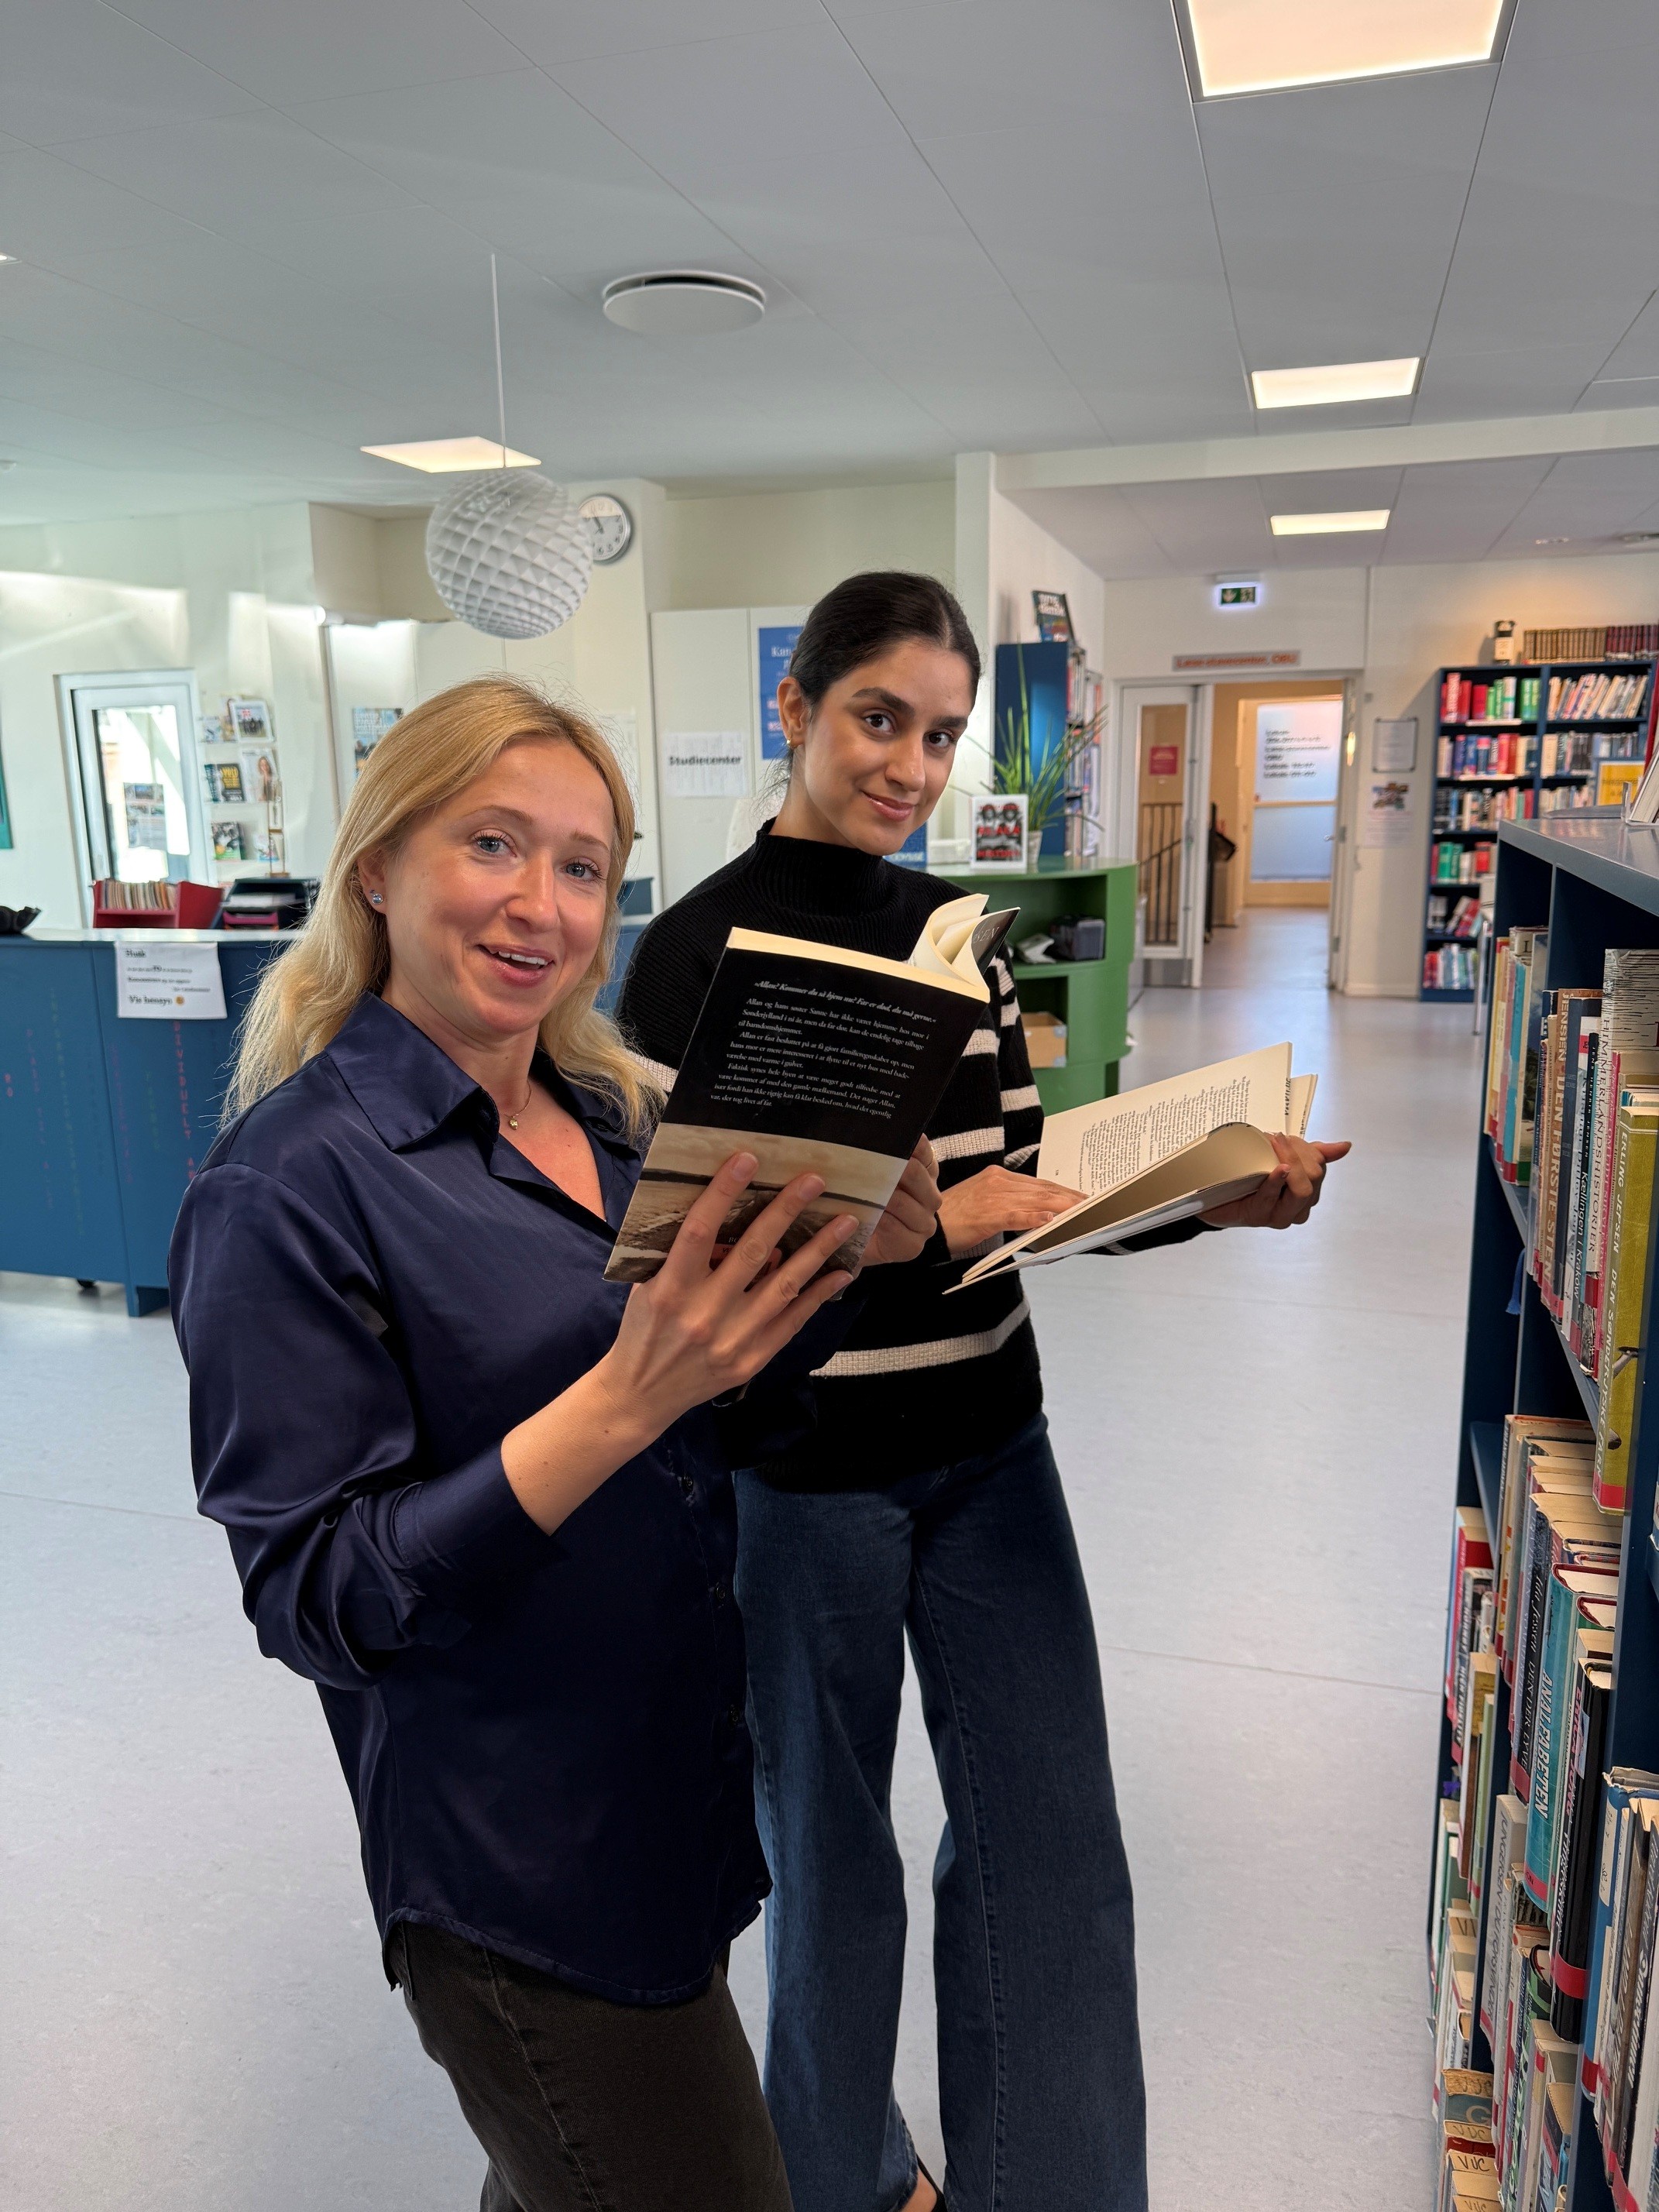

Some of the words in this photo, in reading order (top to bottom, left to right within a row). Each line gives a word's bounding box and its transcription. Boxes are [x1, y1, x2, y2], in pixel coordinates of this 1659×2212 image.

[668, 753, 744, 767] Studiecenter
[974, 926, 1000, 944] SEN
[742, 1009, 784, 1020] Sønderjylland
[869, 1032, 891, 1042] endelig
[905, 1040, 924, 1050] tilbage
[746, 998, 763, 1006] Allan
[809, 1008, 828, 1016] Sanne
[840, 1013, 854, 1022] ikke
[873, 1020, 898, 1032] hjemme
[898, 1026, 910, 1035] hos
[1557, 992, 1570, 1062] JENSEN
[727, 1063, 748, 1071] Faktisk
[775, 1036, 801, 1046] besluttet
[840, 1047, 889, 1063] familieregnskabet
[782, 1049, 814, 1059] interesseret
[826, 1055, 841, 1063] flytte
[733, 1073, 758, 1083] kommet
[1554, 1075, 1565, 1121] DEN
[812, 1096, 833, 1104] besked
[844, 1101, 860, 1110] hvad
[869, 1109, 891, 1118] egentlig
[1588, 1019, 1610, 1252] HIMMERLANDSHISTORIER
[1547, 1129, 1564, 1212] FØRSTE
[1617, 1132, 1628, 1187] ERLING
[1577, 1171, 1589, 1235] Kællingen
[1613, 1194, 1623, 1254] JEPSEN
[1544, 1219, 1556, 1281] STEN
[1573, 1249, 1582, 1299] Krakow
[1609, 1269, 1617, 1304] DEN
[1599, 1309, 1614, 1429] SØNDERJYSKE
[1595, 1431, 1605, 1478] FARM
[1534, 1575, 1543, 1602] Ida
[1530, 1600, 1541, 1654] Jessen
[1527, 1661, 1535, 1695] DEN
[1524, 1696, 1534, 1728] DER
[1569, 1685, 1582, 1754] ERICA
[1520, 1732, 1530, 1771] LYVE
[1534, 1670, 1553, 1820] ANALFABETEN
[1563, 1758, 1575, 1817] JONG
[1494, 1811, 1509, 1898] JUNGERSEN
[1492, 1905, 1502, 1932] DU
[1486, 1932, 1499, 2022] FORSVINDER
[1452, 2124, 1486, 2142] VUC
[1457, 2155, 1490, 2172] VUC
